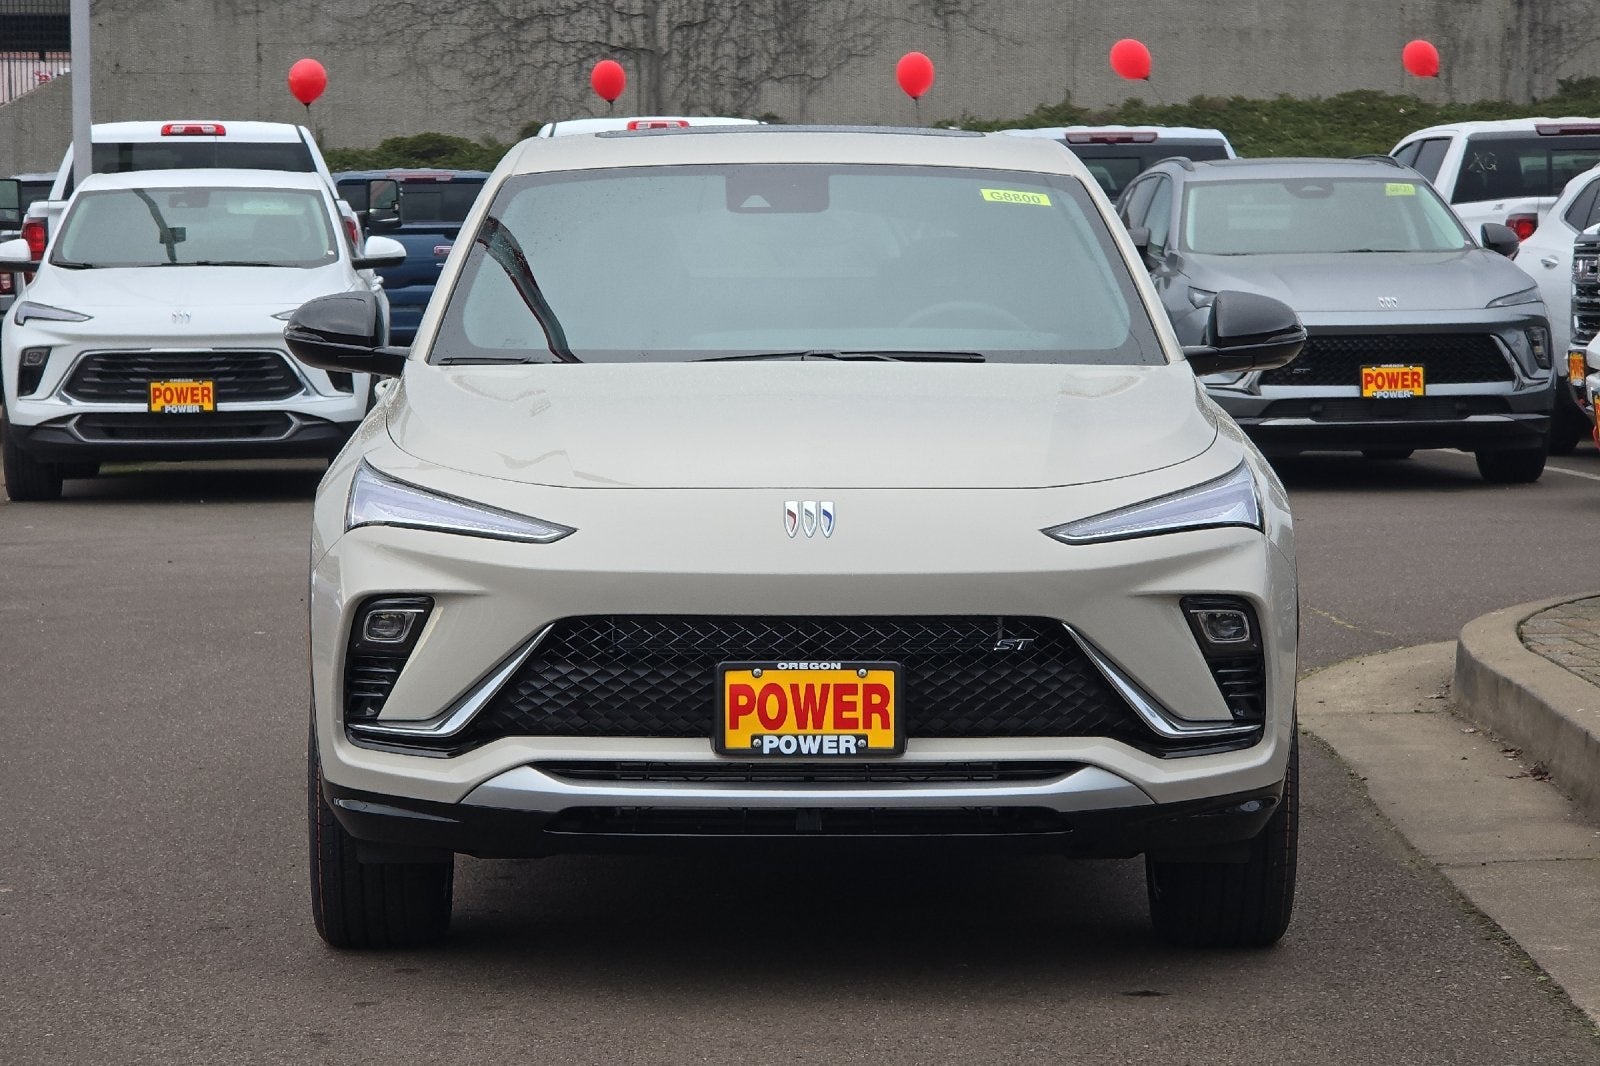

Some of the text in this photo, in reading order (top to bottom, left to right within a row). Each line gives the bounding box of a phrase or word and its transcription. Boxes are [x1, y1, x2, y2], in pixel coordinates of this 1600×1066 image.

[990, 191, 1041, 204] G8800
[1363, 371, 1422, 390] POWER
[152, 386, 212, 404] POWER
[164, 405, 200, 413] POWER
[993, 638, 1035, 650] ST
[777, 662, 842, 670] OREGON
[728, 682, 891, 731] POWER
[762, 735, 857, 755] POWER
